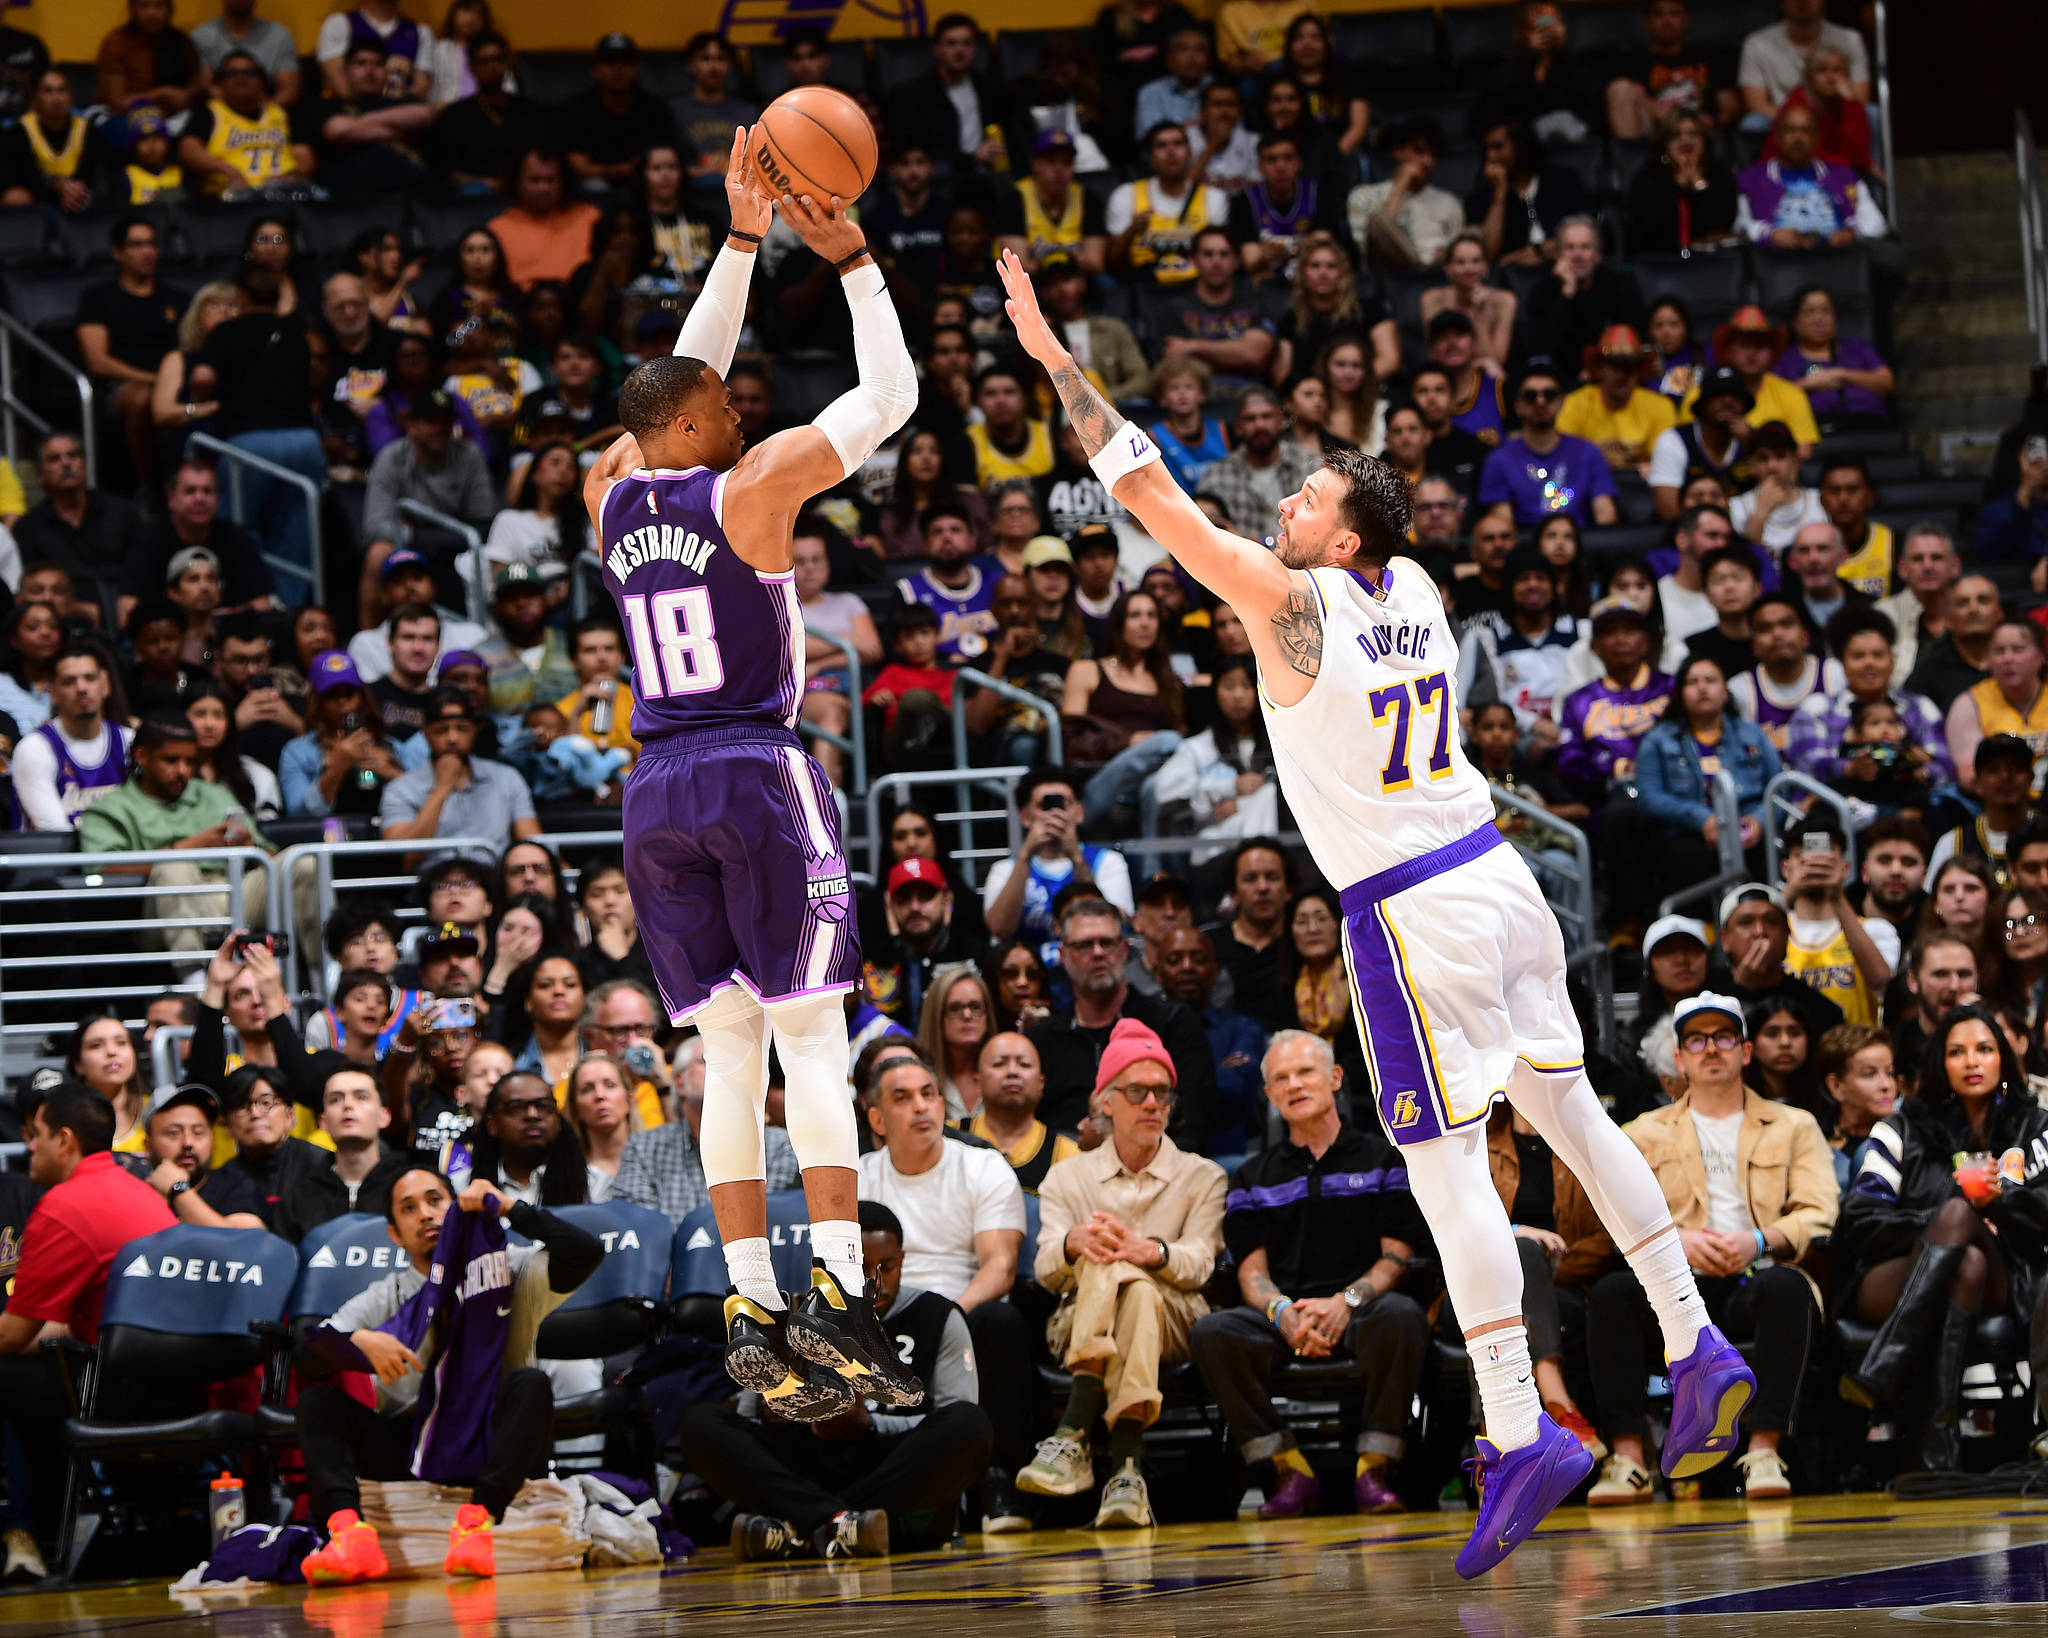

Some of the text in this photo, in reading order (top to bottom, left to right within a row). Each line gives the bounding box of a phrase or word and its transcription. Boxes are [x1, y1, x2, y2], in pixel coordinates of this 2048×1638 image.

[606, 523, 718, 586] WESTBROOK
[621, 585, 726, 700] 18
[1367, 668, 1454, 795] 77
[806, 877, 849, 899] KINGS
[158, 1255, 264, 1287] DELTA
[345, 1245, 411, 1269] DEL
